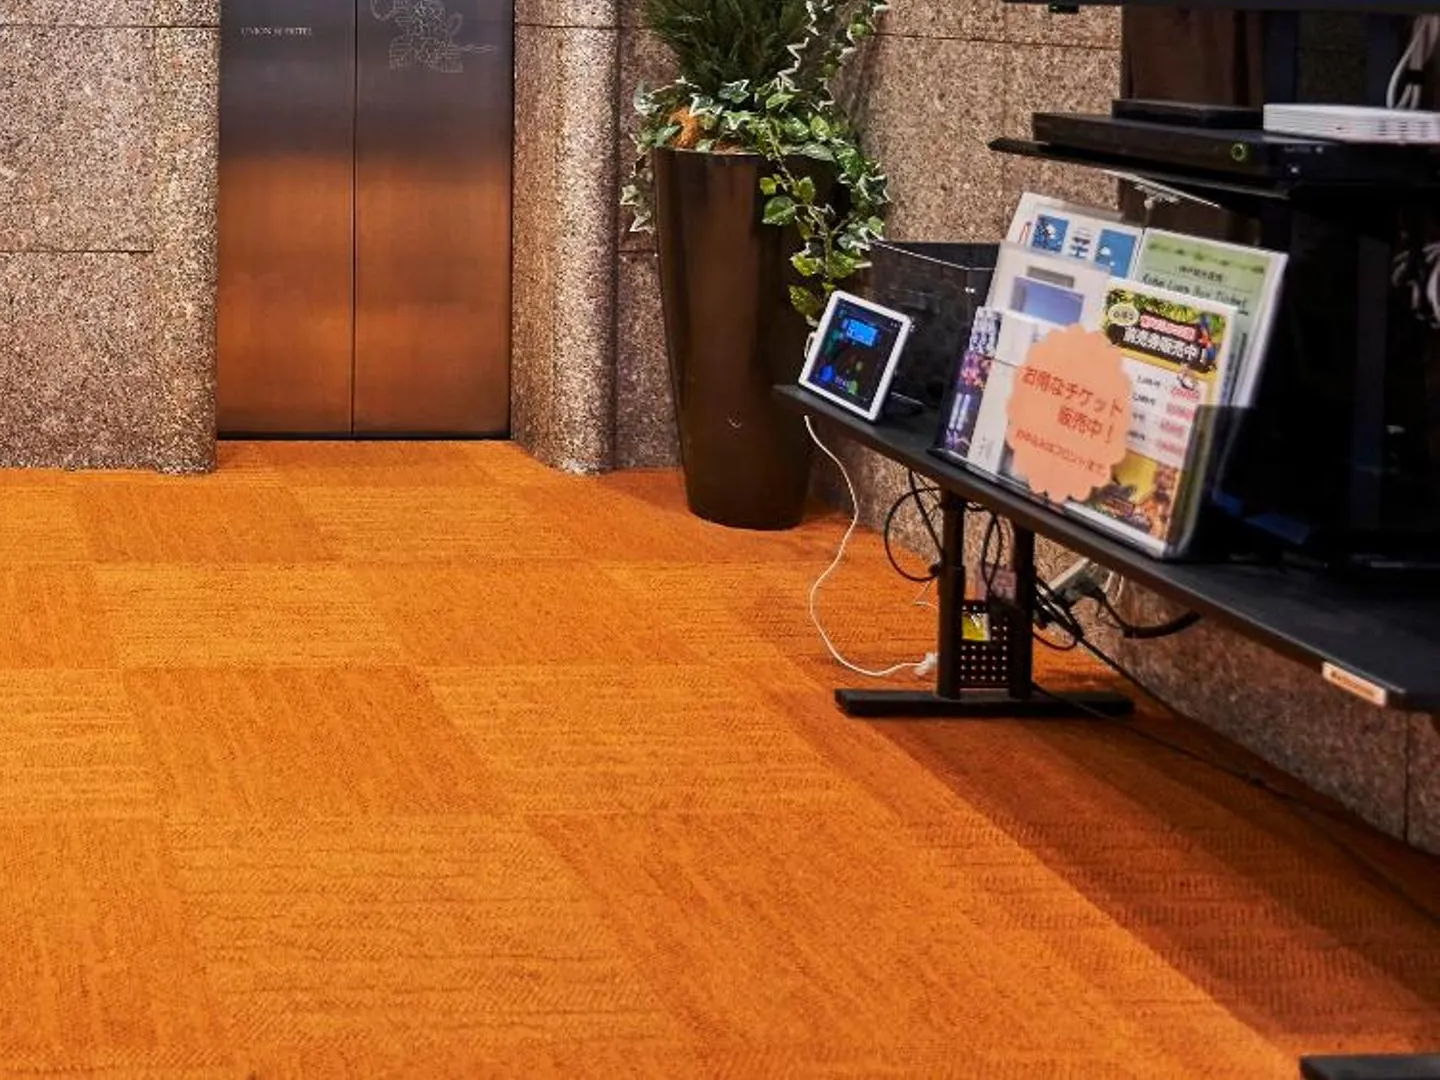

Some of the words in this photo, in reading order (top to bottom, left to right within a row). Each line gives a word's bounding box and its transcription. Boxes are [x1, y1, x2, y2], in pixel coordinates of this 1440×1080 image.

[1022, 366, 1123, 415] お得なチケット
